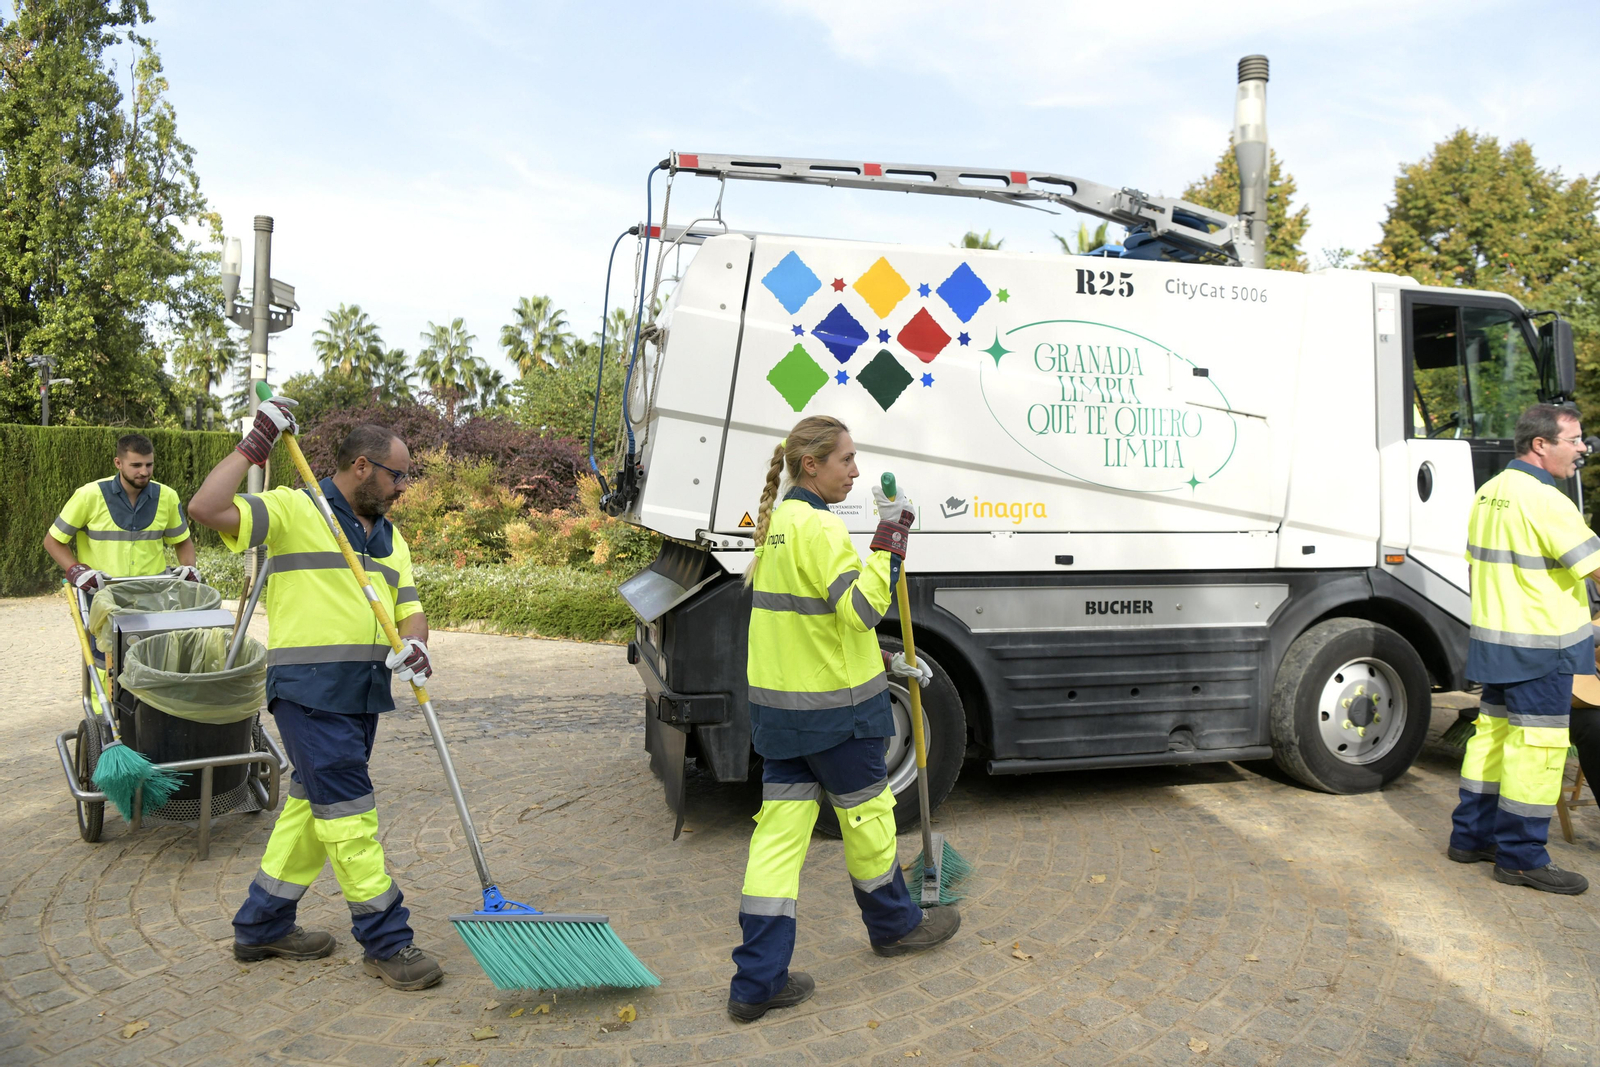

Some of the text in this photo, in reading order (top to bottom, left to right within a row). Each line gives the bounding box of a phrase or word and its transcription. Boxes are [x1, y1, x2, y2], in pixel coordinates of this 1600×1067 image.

[1075, 268, 1135, 297] R25
[1164, 278, 1268, 303] CityCat 5006
[1034, 342, 1143, 376] GRANADA
[1057, 375, 1142, 404] LIMPIA
[1027, 403, 1202, 438] QUE TE QUIERO
[1103, 438, 1185, 468] LIMPIA
[973, 495, 1048, 525] inagra
[1085, 600, 1153, 615] BUCHER
